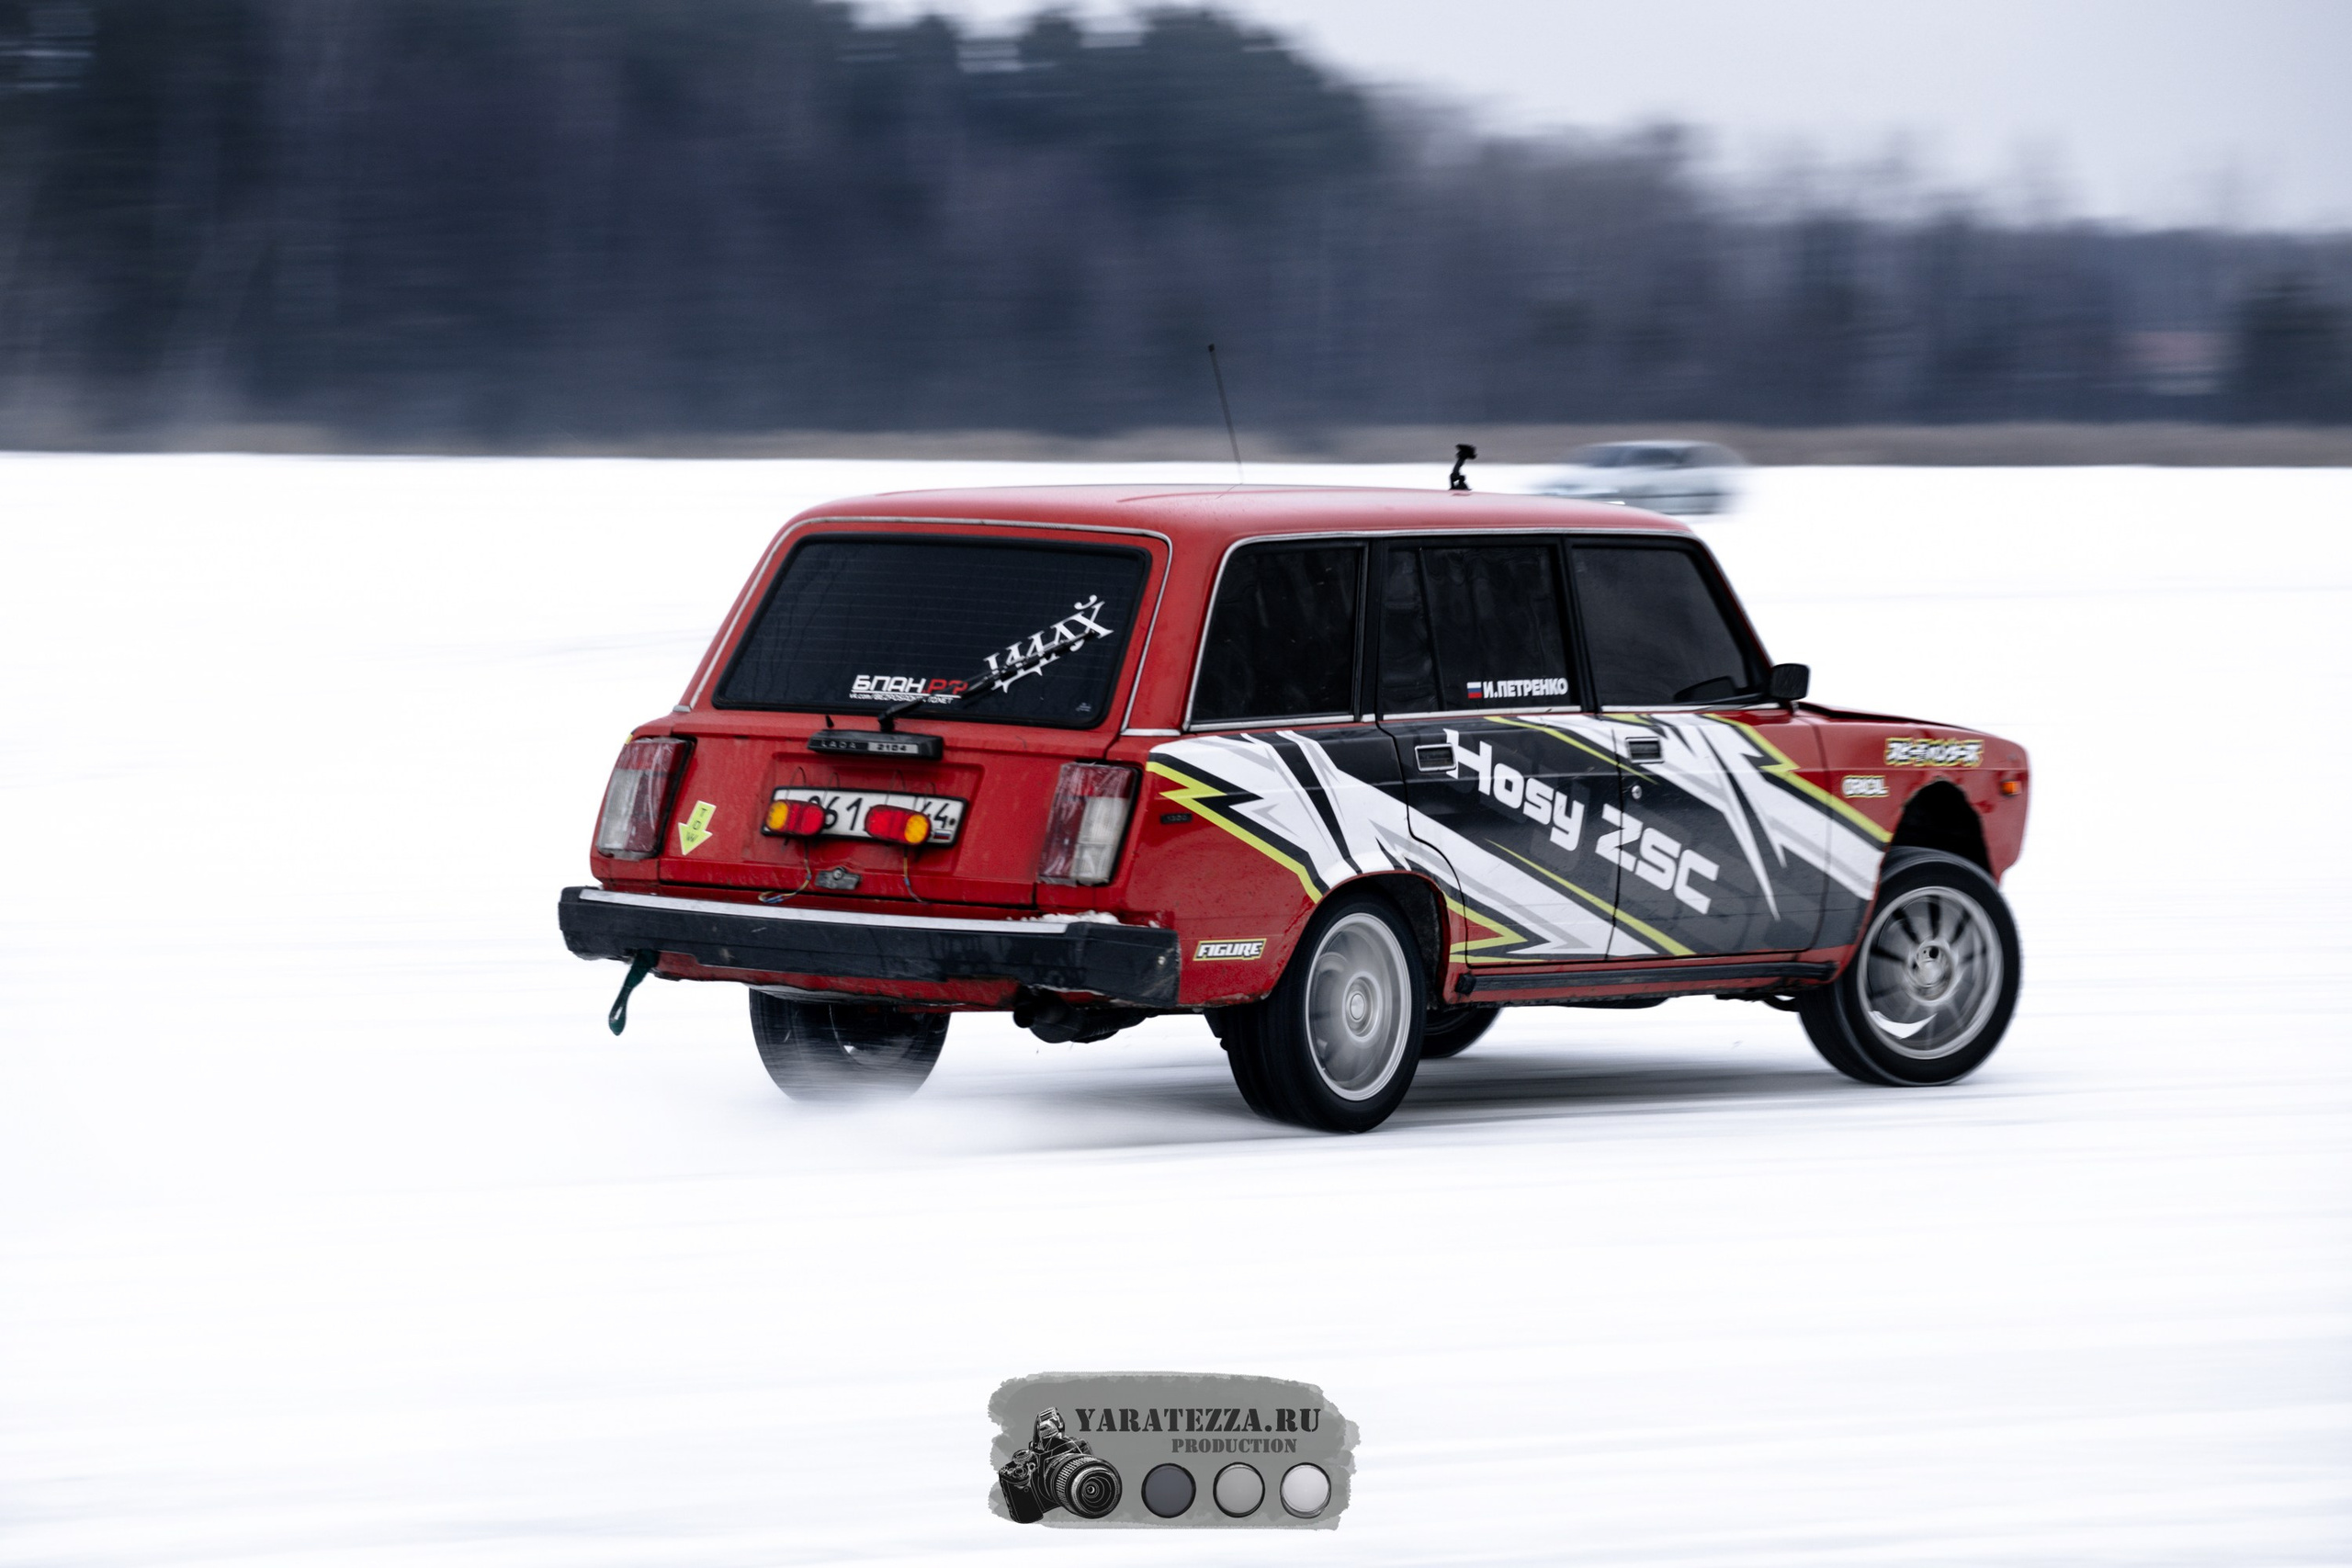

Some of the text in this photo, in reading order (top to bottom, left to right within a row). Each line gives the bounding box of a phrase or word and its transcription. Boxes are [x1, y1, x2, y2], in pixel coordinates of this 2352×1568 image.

[1483, 677, 1569, 699] И.ПЕТРЕНКО
[1442, 728, 1586, 852] Hosy
[1197, 942, 1263, 957] FIGURE
